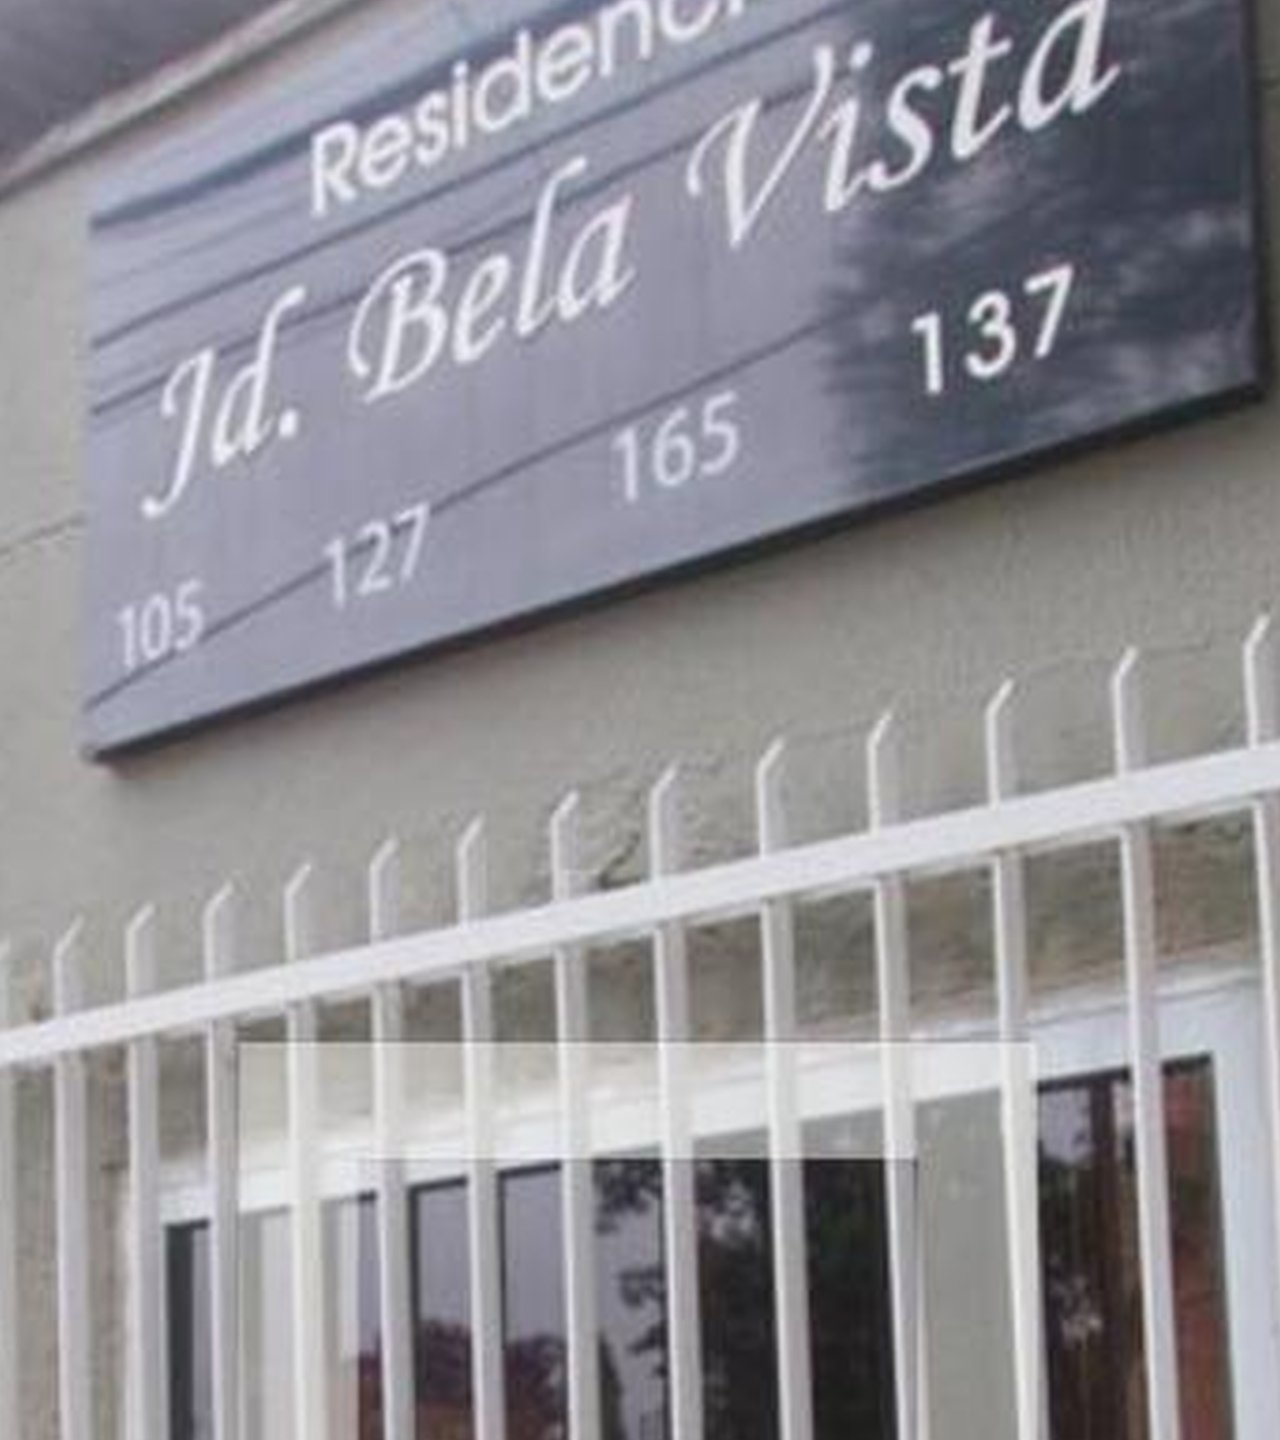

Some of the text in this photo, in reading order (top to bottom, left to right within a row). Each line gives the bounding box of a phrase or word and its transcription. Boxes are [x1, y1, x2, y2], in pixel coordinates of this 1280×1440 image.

[116, 267, 1076, 668] 105 127 165 137
[141, 287, 304, 518] Jd.
[350, 156, 634, 404] Bela
